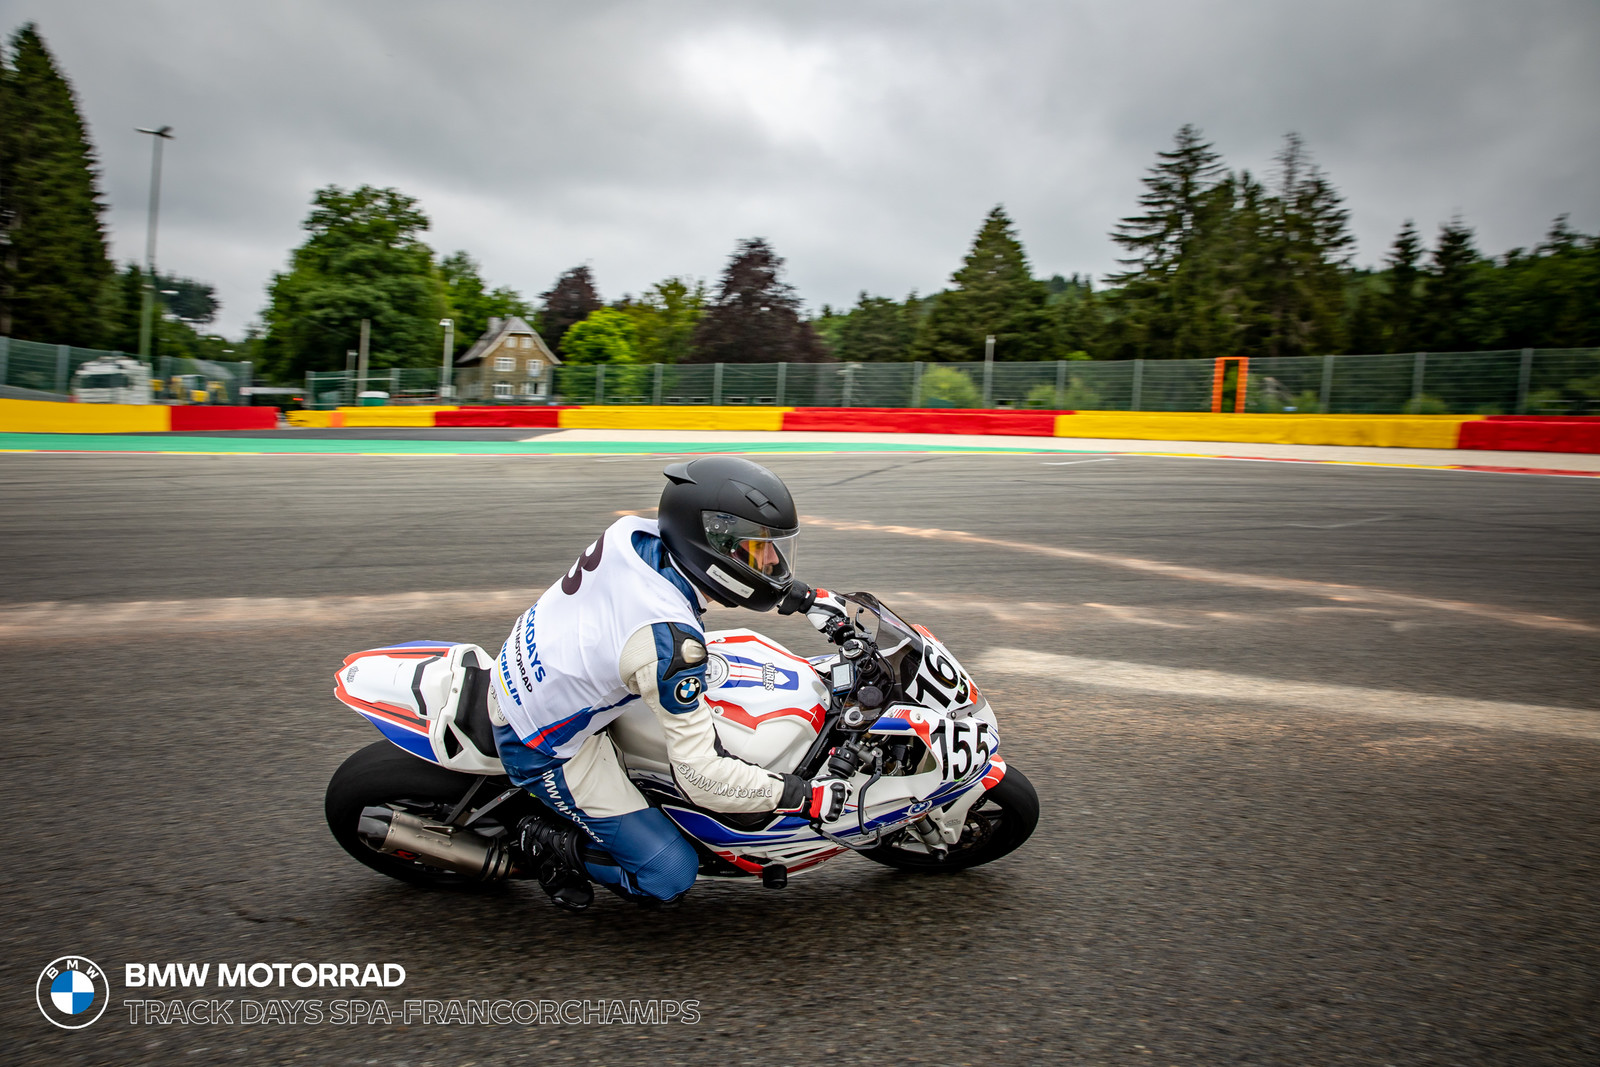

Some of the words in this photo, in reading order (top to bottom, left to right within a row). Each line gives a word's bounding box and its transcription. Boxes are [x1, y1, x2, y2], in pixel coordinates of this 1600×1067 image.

[930, 718, 990, 781] 155
[676, 761, 722, 792] BMW
[718, 782, 773, 798] Motorrad
